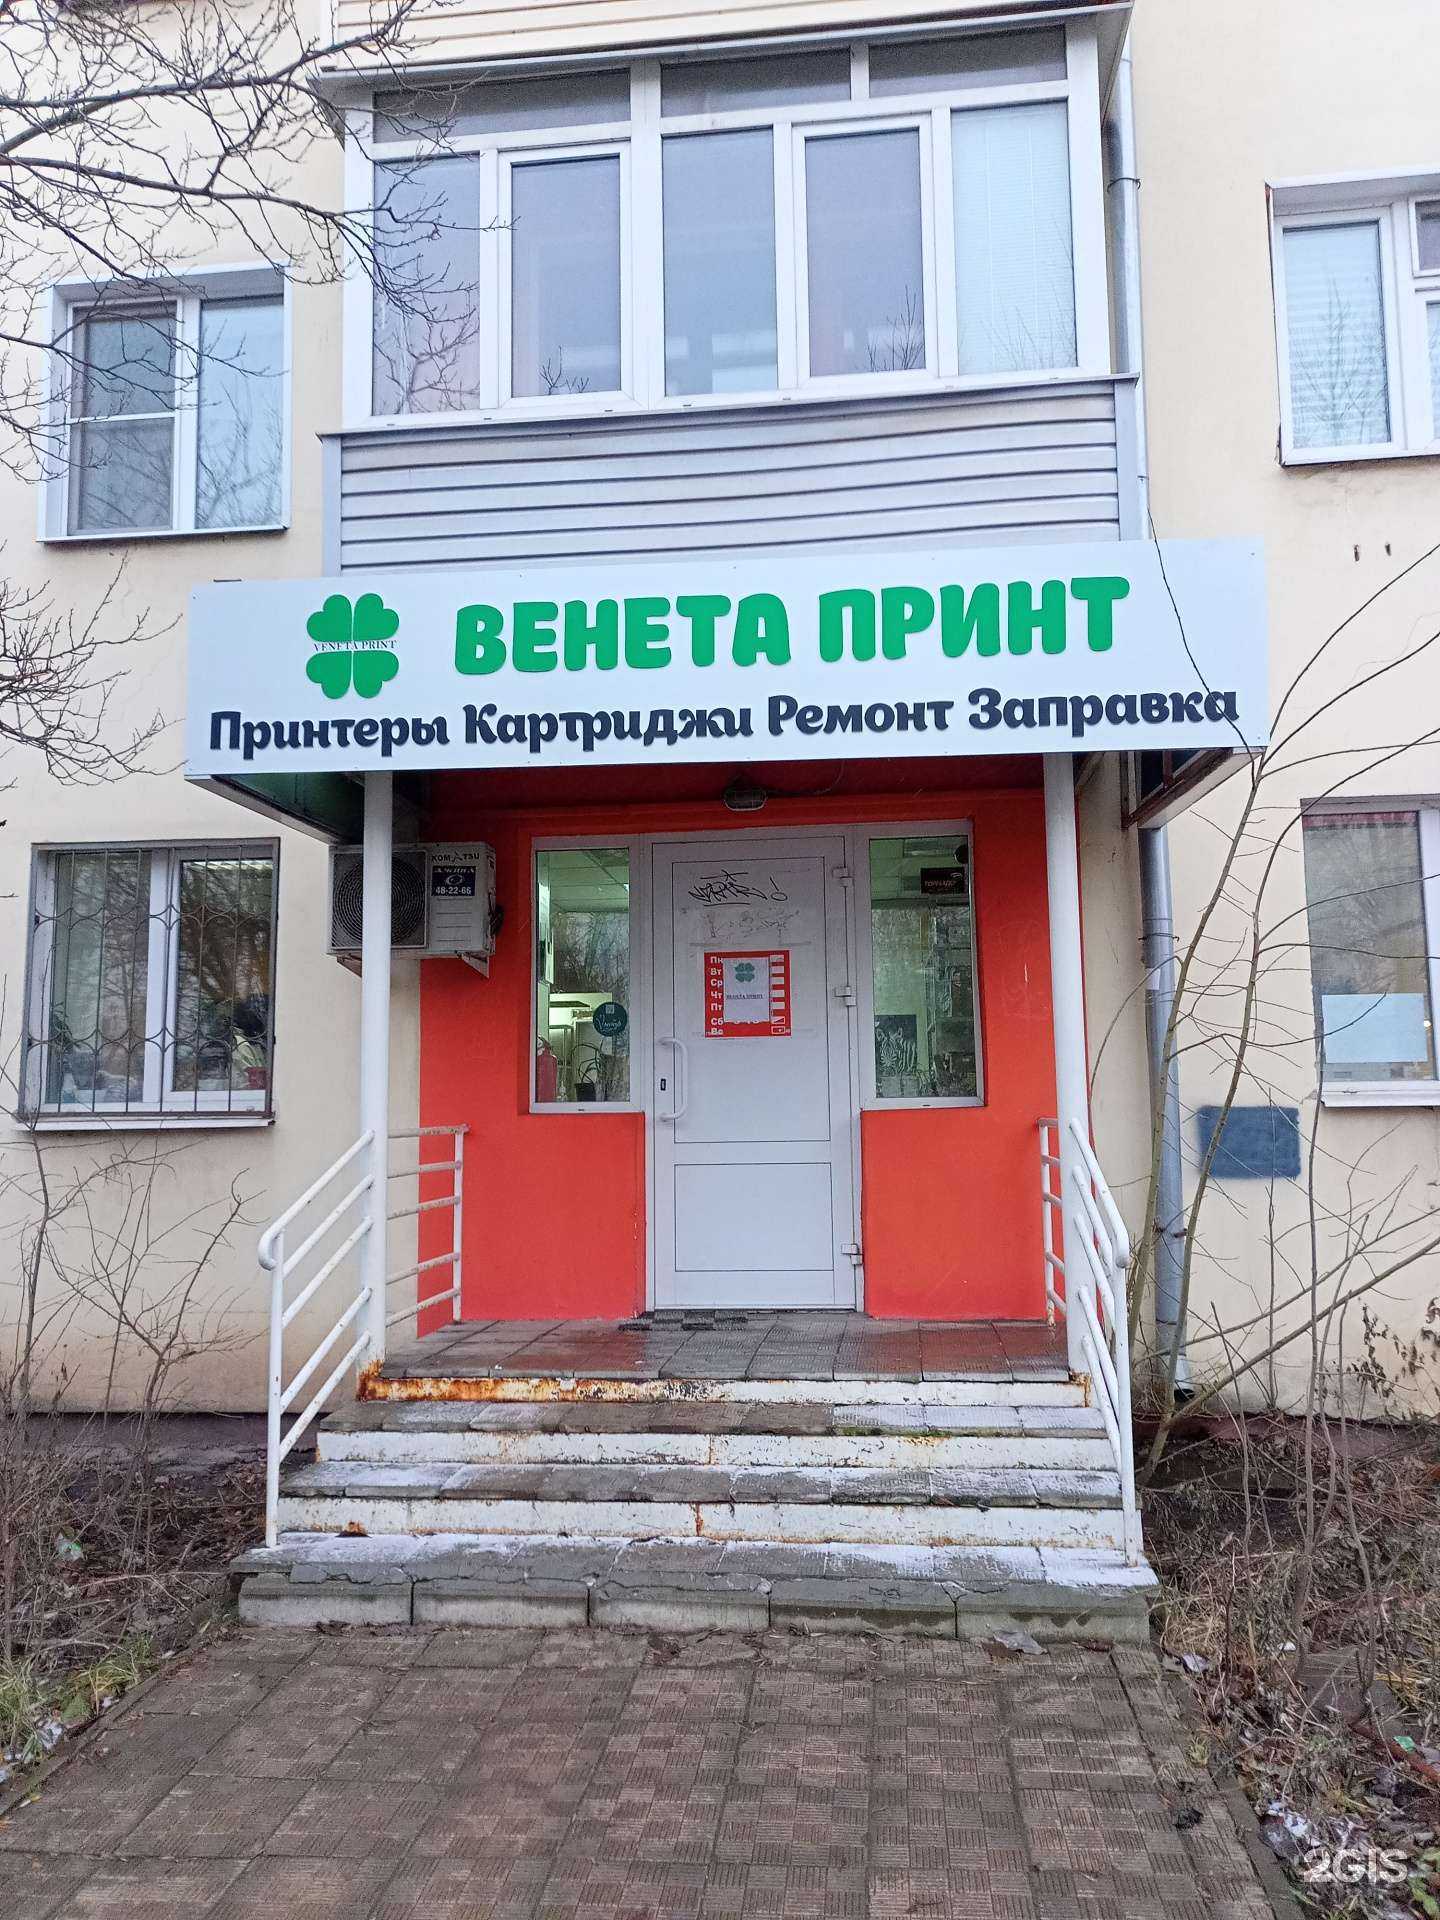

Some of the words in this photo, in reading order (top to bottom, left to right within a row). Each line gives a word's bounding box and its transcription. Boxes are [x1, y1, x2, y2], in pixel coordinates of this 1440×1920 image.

[312, 641, 359, 652] VENETA
[361, 639, 397, 650] PRINT
[454, 593, 792, 675] ВЕНЕТА
[818, 576, 1131, 663] ПРИНТ
[209, 711, 450, 760] Принтеры
[462, 703, 754, 754] Картриджи
[767, 695, 955, 737] Ремонт
[967, 687, 1240, 738] Заправка
